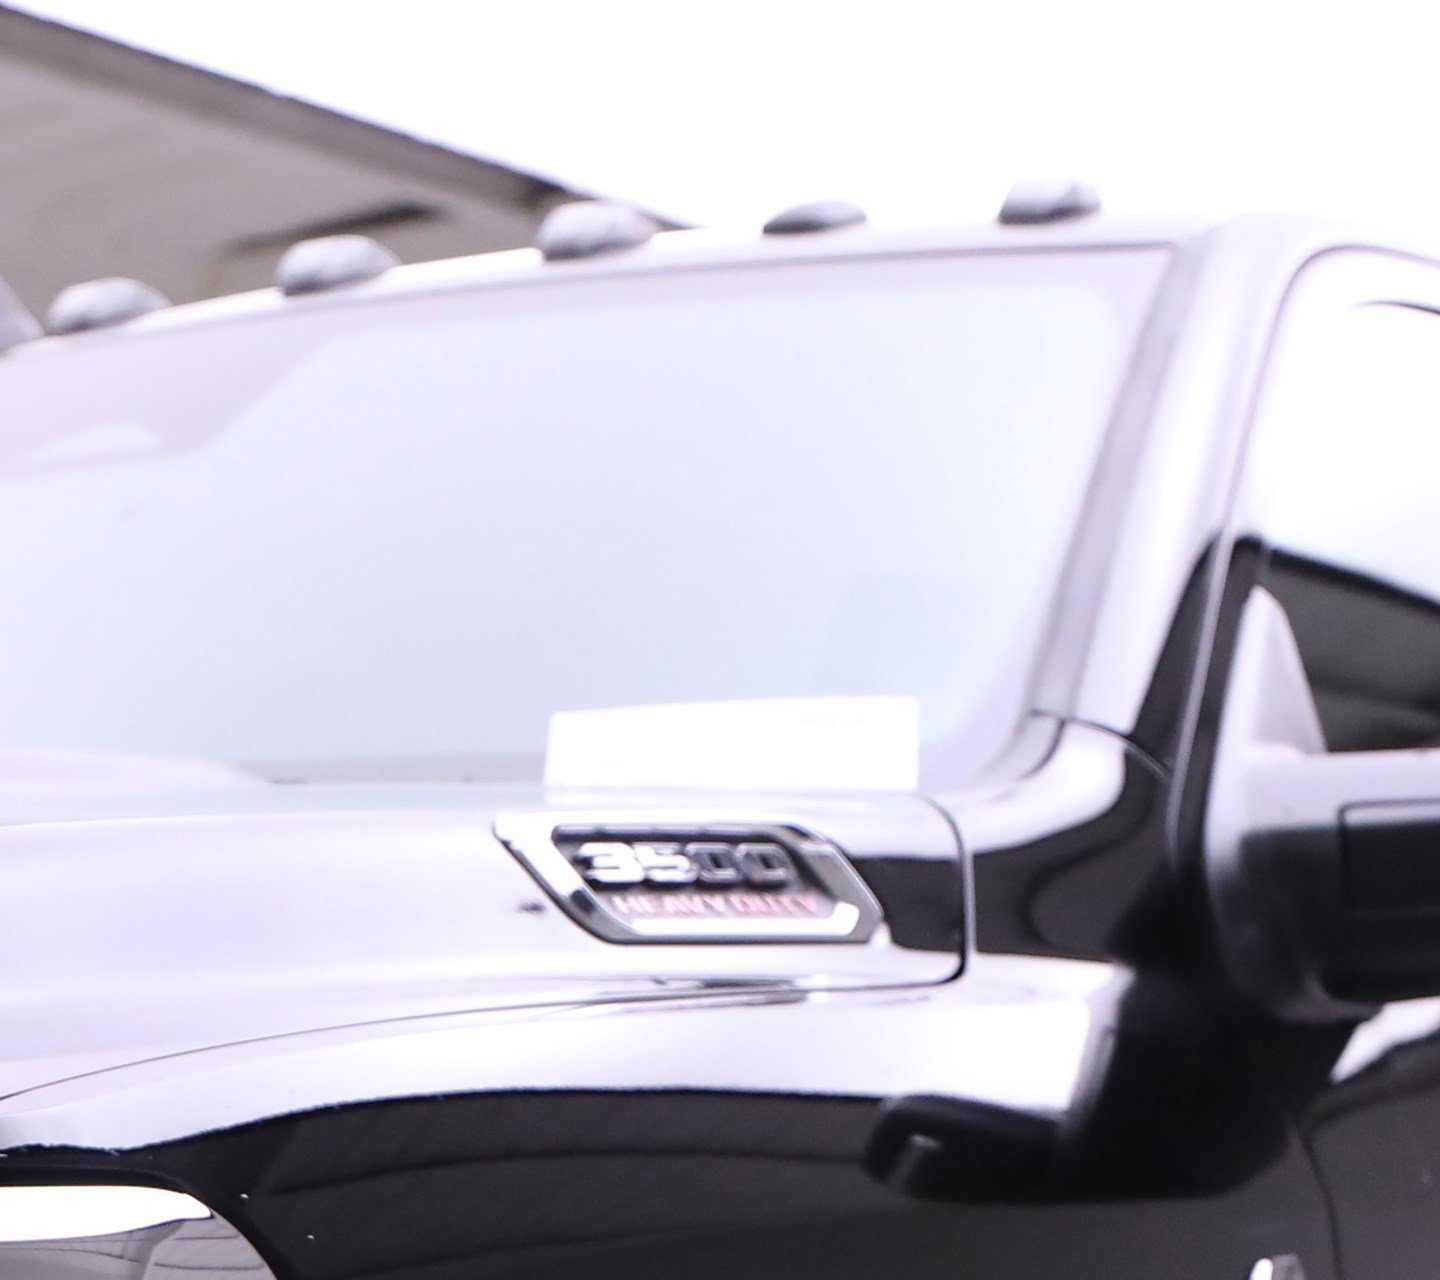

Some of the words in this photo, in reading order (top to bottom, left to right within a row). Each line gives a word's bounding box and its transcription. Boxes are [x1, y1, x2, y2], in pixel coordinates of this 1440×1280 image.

[575, 841, 798, 884] 3500
[611, 895, 727, 916] HEAVY
[729, 895, 819, 916] DUTY
